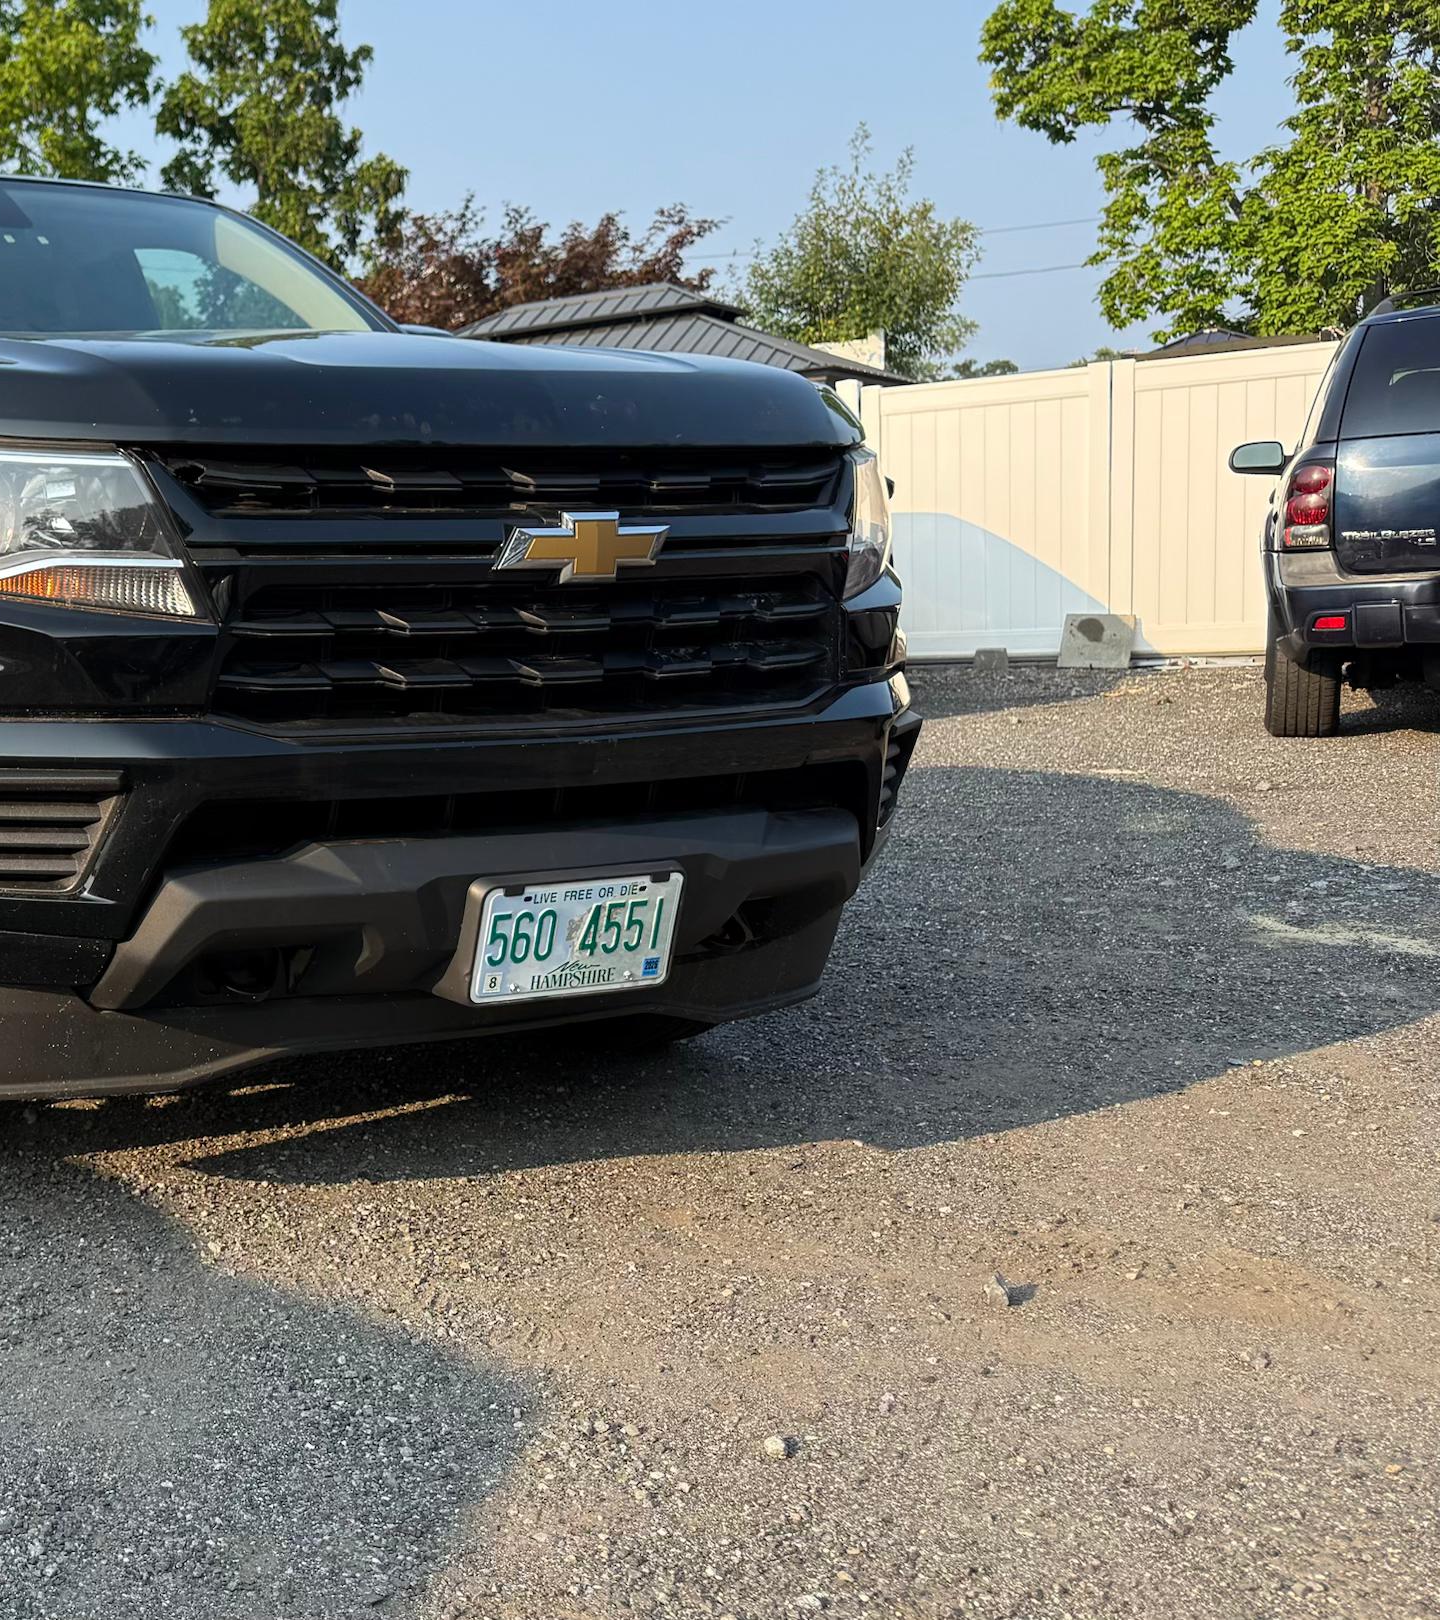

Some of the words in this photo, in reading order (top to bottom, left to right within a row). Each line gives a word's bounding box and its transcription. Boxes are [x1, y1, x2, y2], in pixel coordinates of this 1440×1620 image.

[1341, 529, 1435, 540] TRAILBLAZER
[533, 892, 558, 904] LIVE
[564, 888, 593, 902] FREE
[598, 886, 614, 898] OR
[620, 884, 638, 896] DIE
[486, 908, 557, 967] 560
[578, 897, 664, 957] 4551
[547, 960, 601, 974] New
[488, 976, 497, 989] 8
[530, 967, 616, 990] HAMPSHIRE
